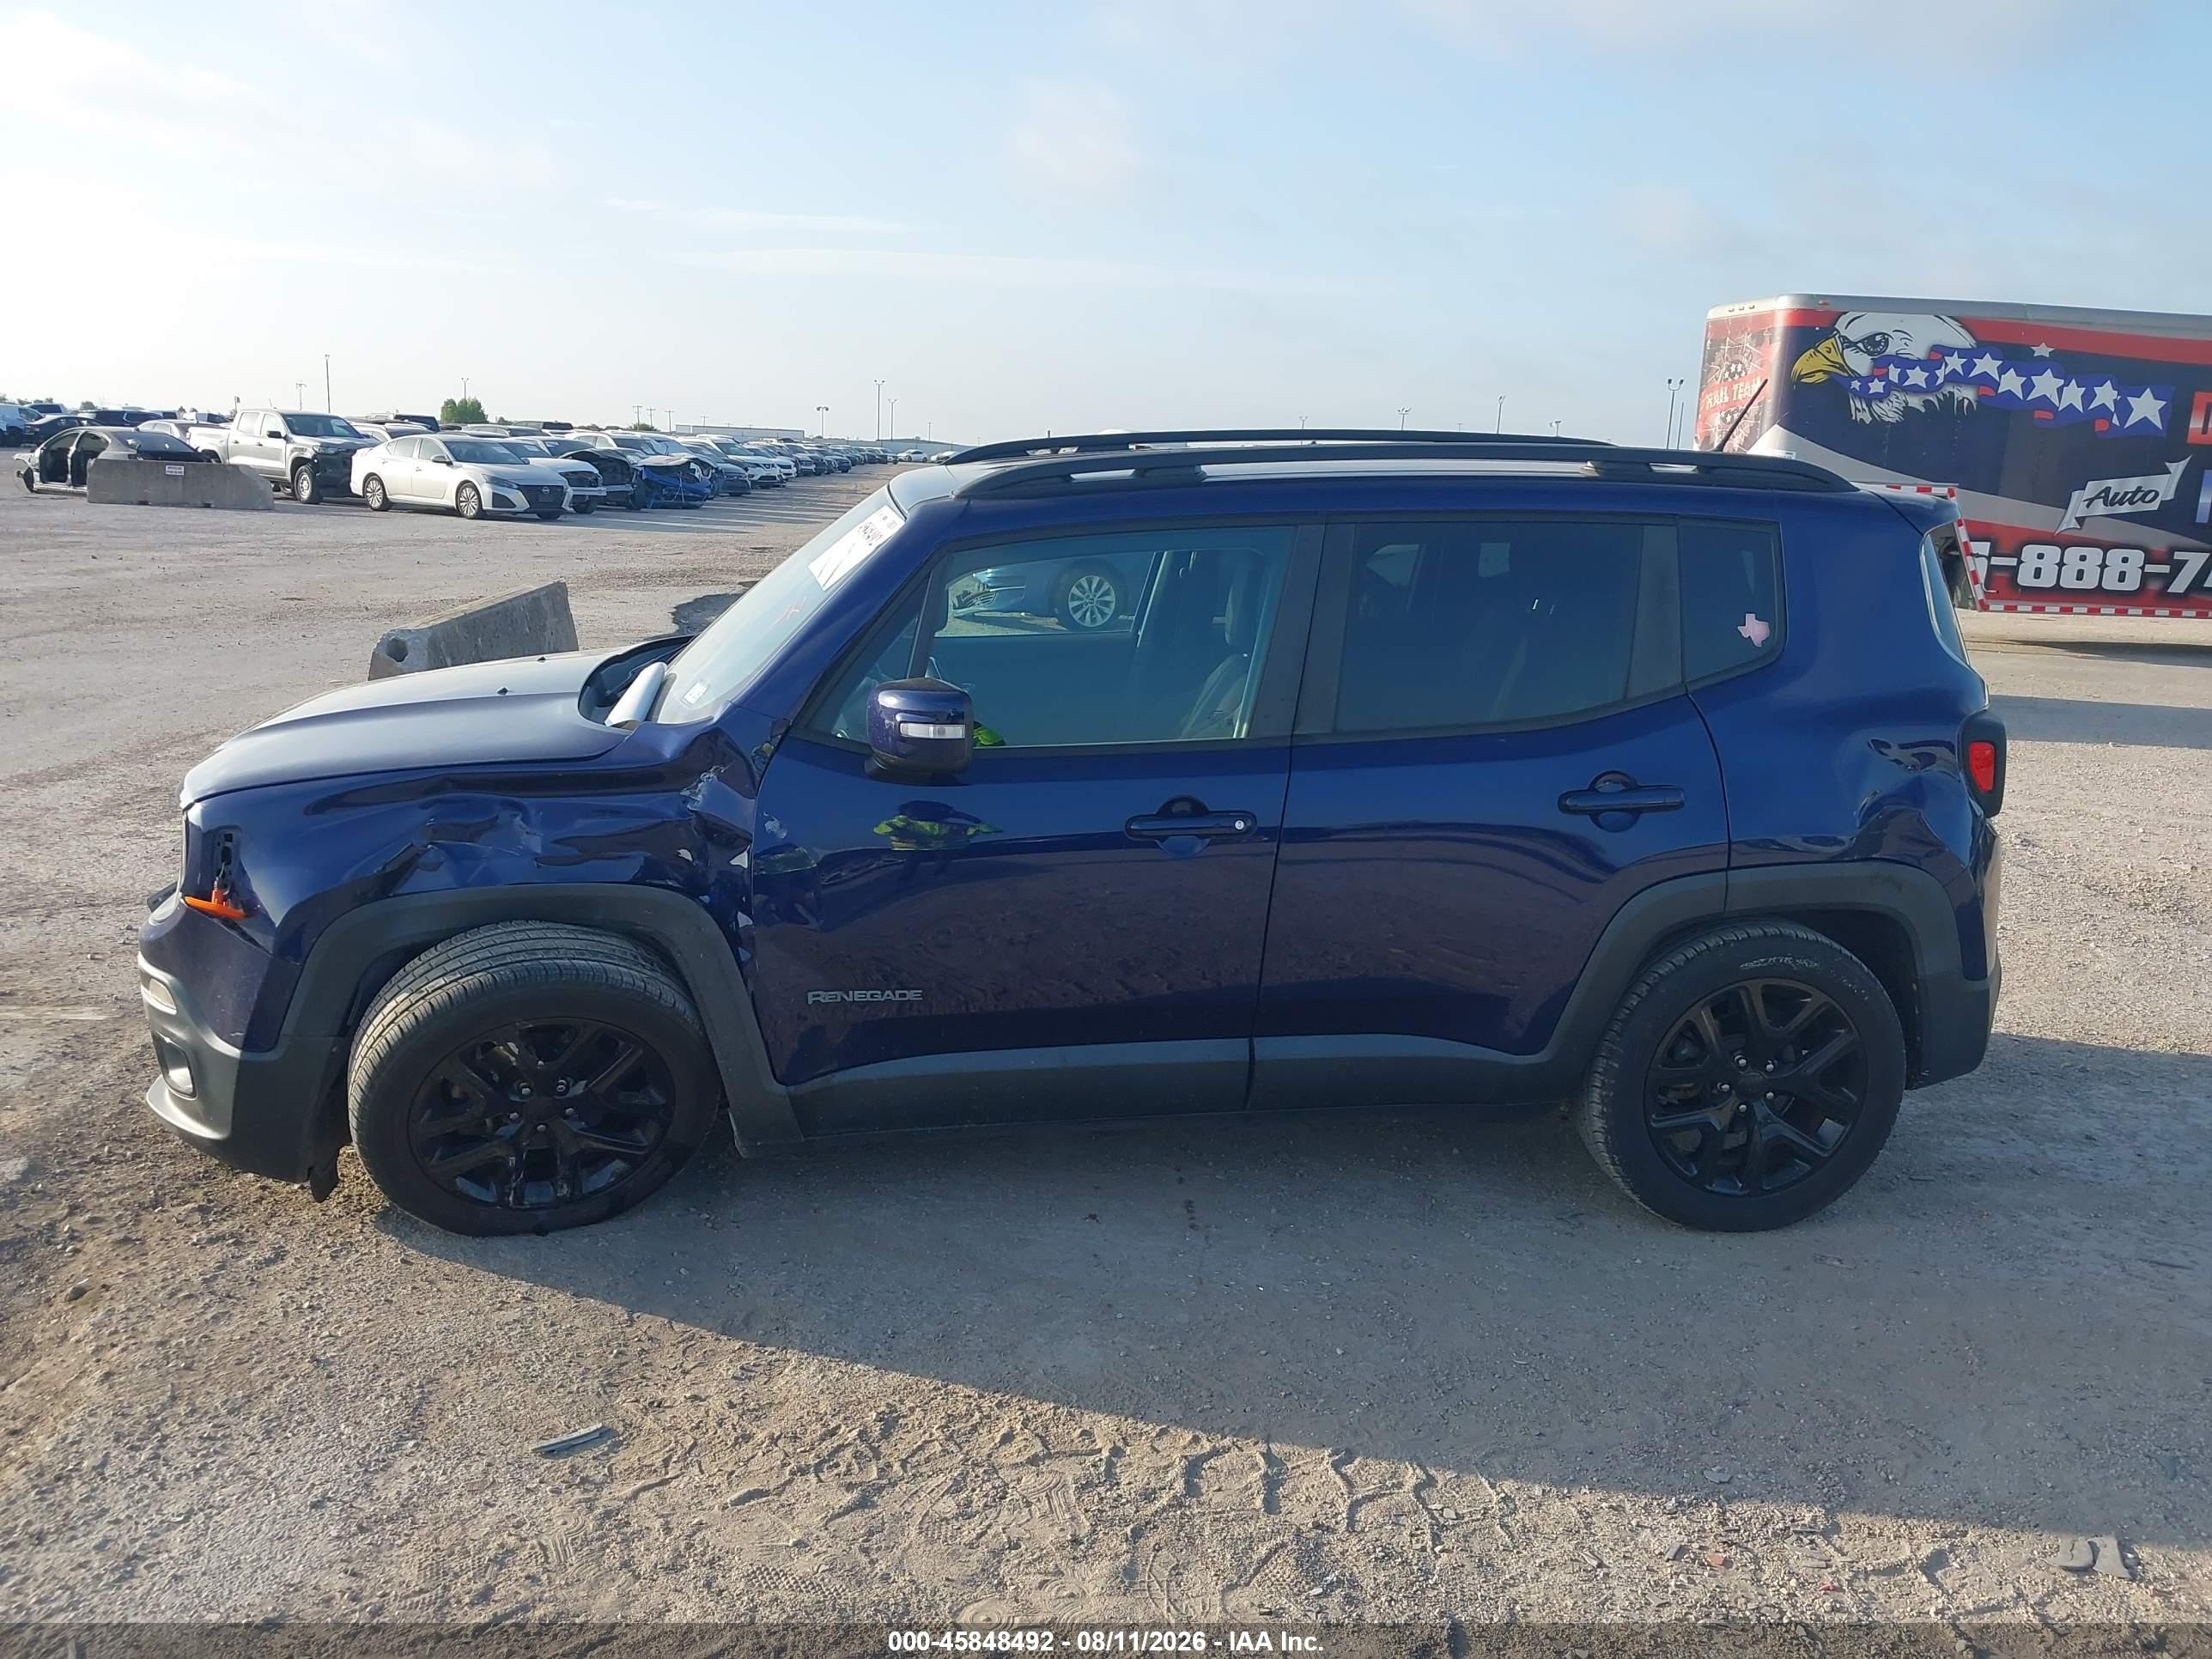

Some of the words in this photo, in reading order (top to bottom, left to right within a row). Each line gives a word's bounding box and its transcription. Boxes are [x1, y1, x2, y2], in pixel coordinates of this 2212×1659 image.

[2082, 485, 2160, 508] Auto
[1972, 541, 2212, 593] -888-7
[807, 990, 923, 1005] RENEGADE
